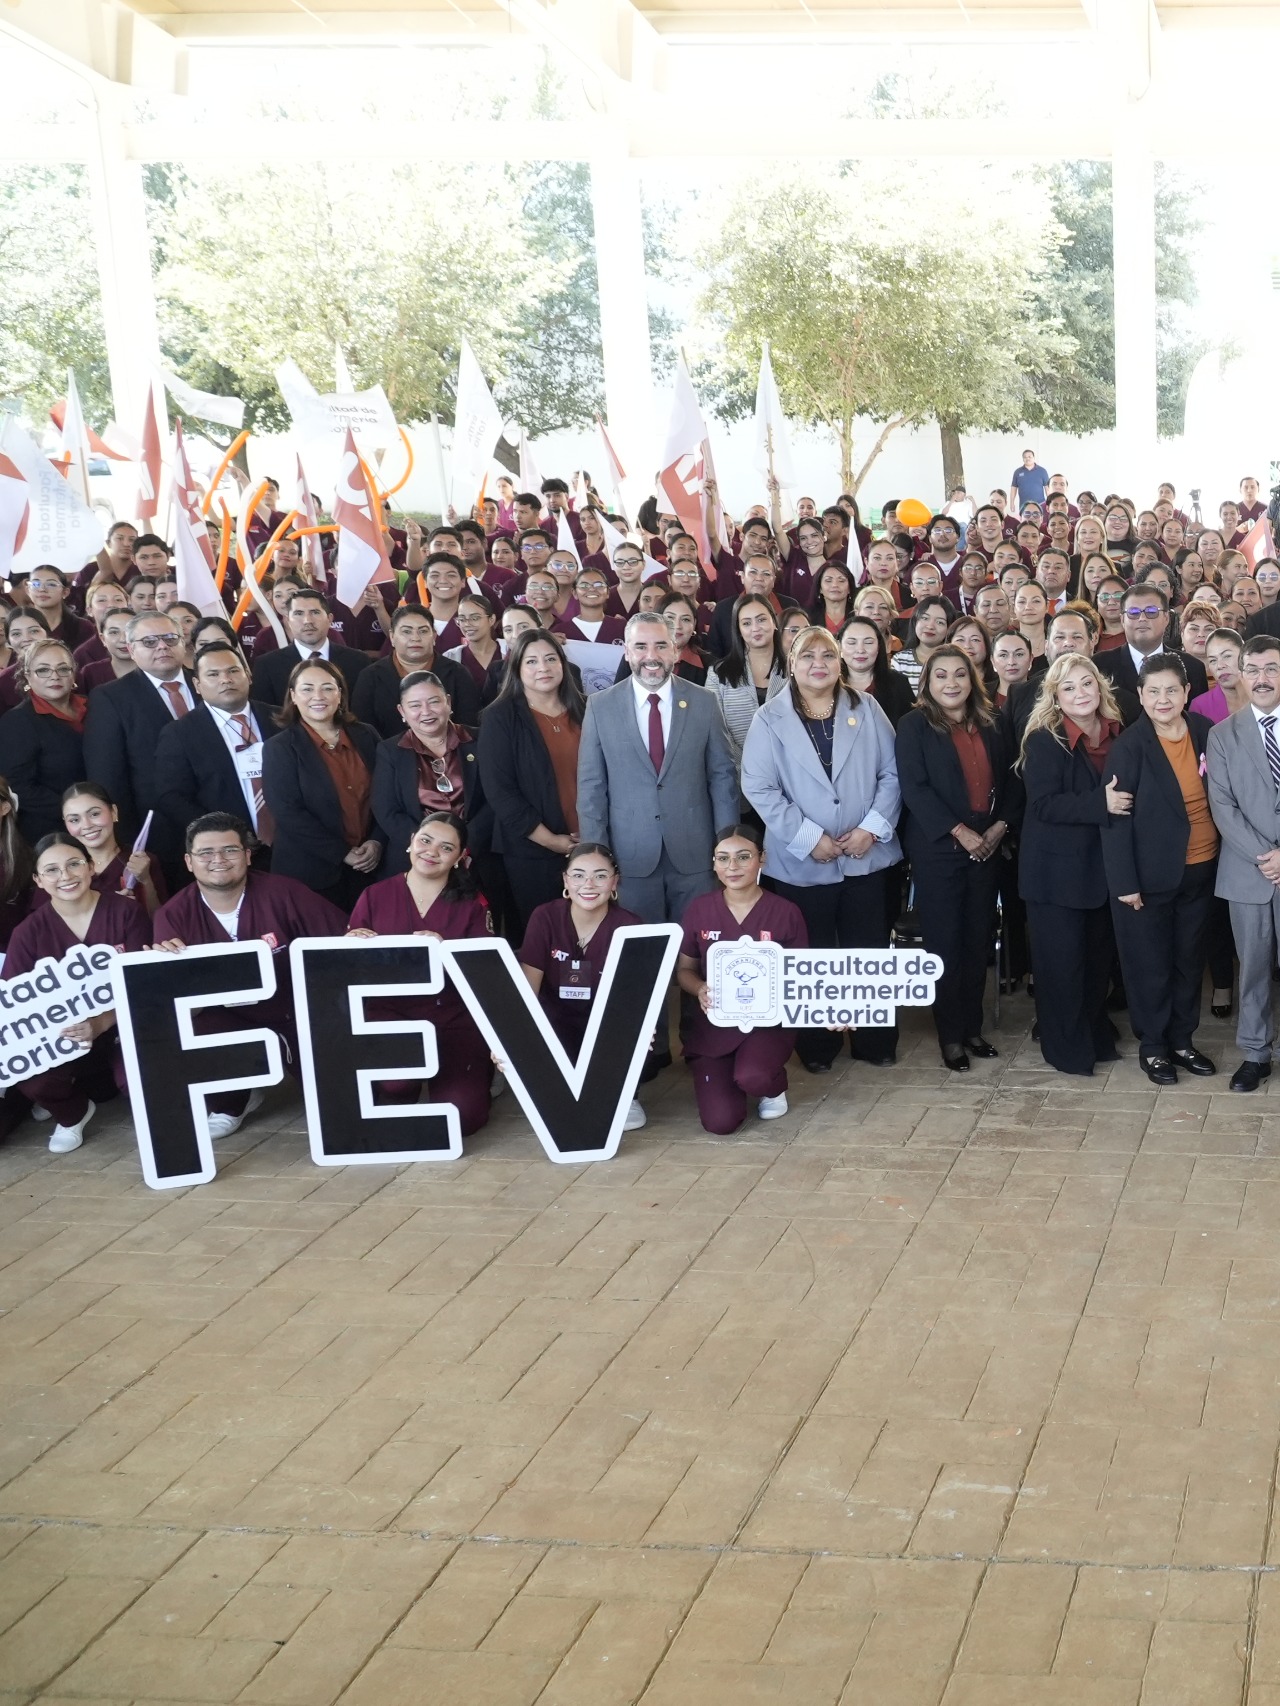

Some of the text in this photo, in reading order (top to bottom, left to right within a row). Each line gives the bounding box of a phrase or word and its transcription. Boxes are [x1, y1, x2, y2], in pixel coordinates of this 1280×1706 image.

[66, 951, 111, 981] de
[783, 955, 937, 976] Facultad de
[565, 990, 585, 998] STAFF
[783, 978, 928, 1000] Enfermería
[783, 1004, 888, 1025] Victoria
[123, 935, 671, 1178] FEV
